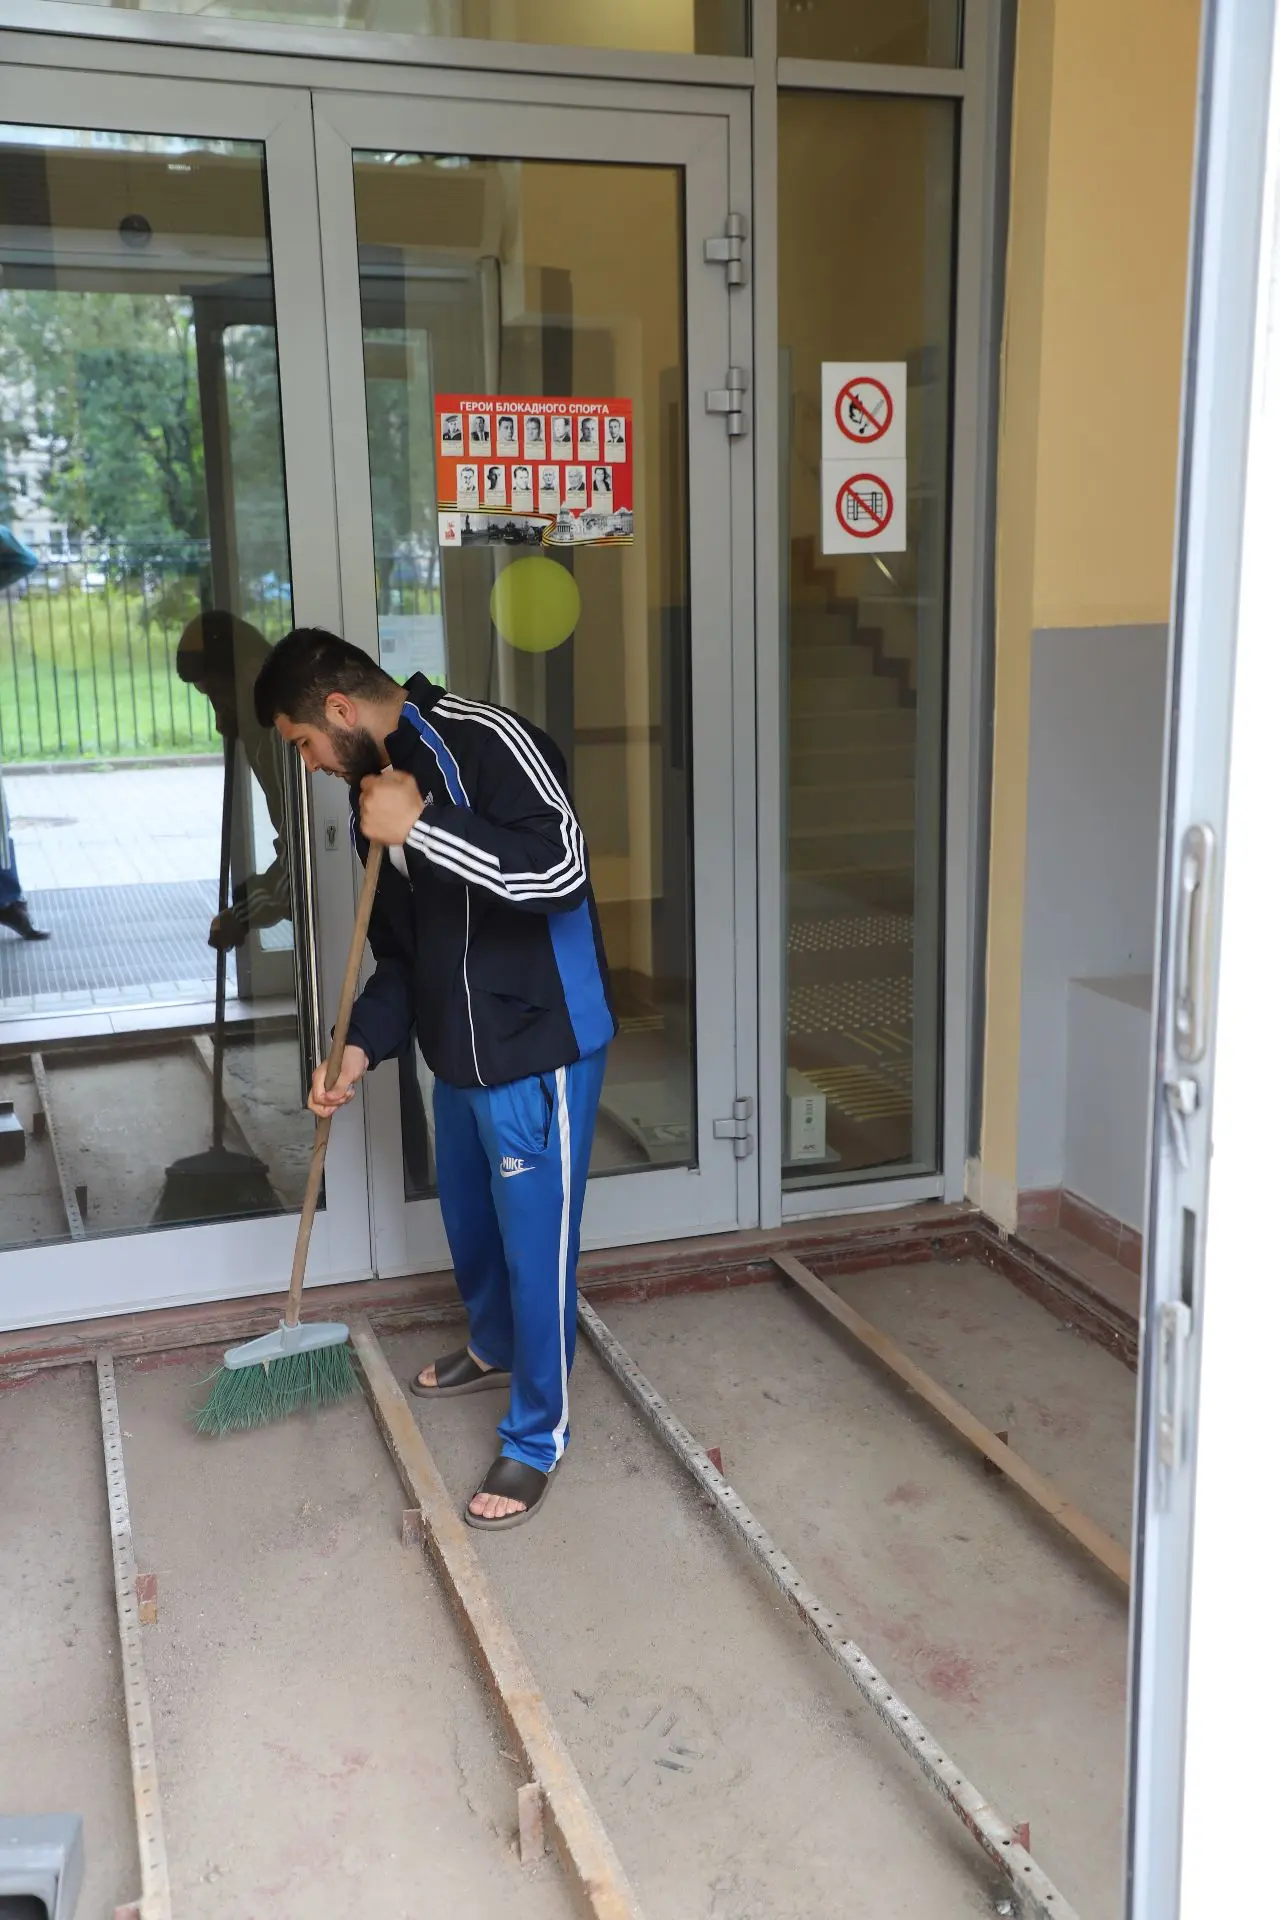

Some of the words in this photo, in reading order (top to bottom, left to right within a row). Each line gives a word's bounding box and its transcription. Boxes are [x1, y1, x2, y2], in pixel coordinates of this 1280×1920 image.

[460, 401, 493, 411] ГЕРОИ
[496, 402, 567, 414] БЛОКАДНОГО
[569, 403, 609, 414] СПОРТА
[502, 1156, 524, 1170] NIKE
